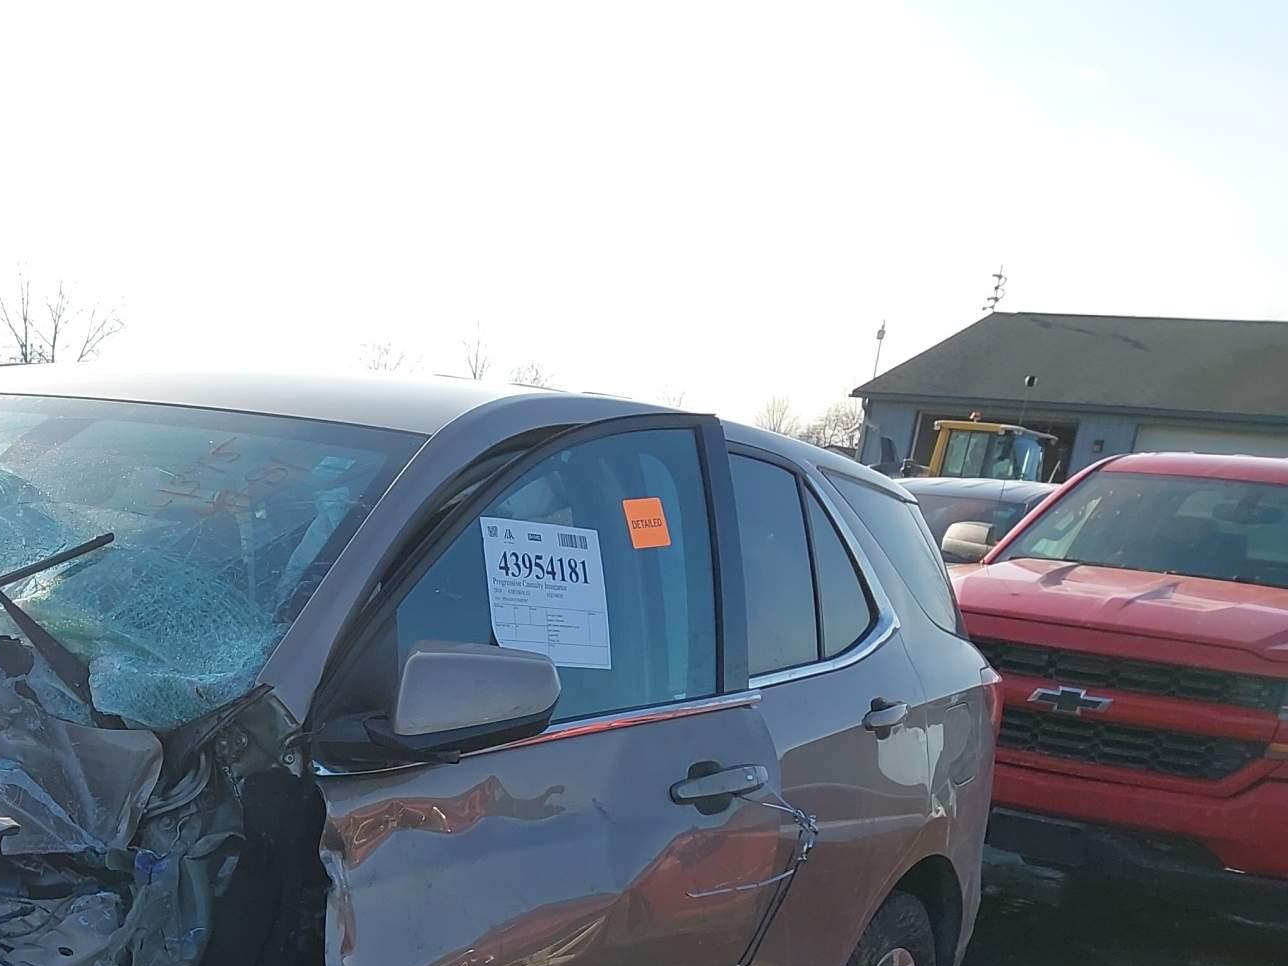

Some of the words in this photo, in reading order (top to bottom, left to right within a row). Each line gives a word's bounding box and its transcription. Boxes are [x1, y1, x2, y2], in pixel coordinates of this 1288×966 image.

[632, 518, 663, 530] DETAILED
[498, 551, 591, 585] 43954181
[493, 577, 522, 588] Progressive
